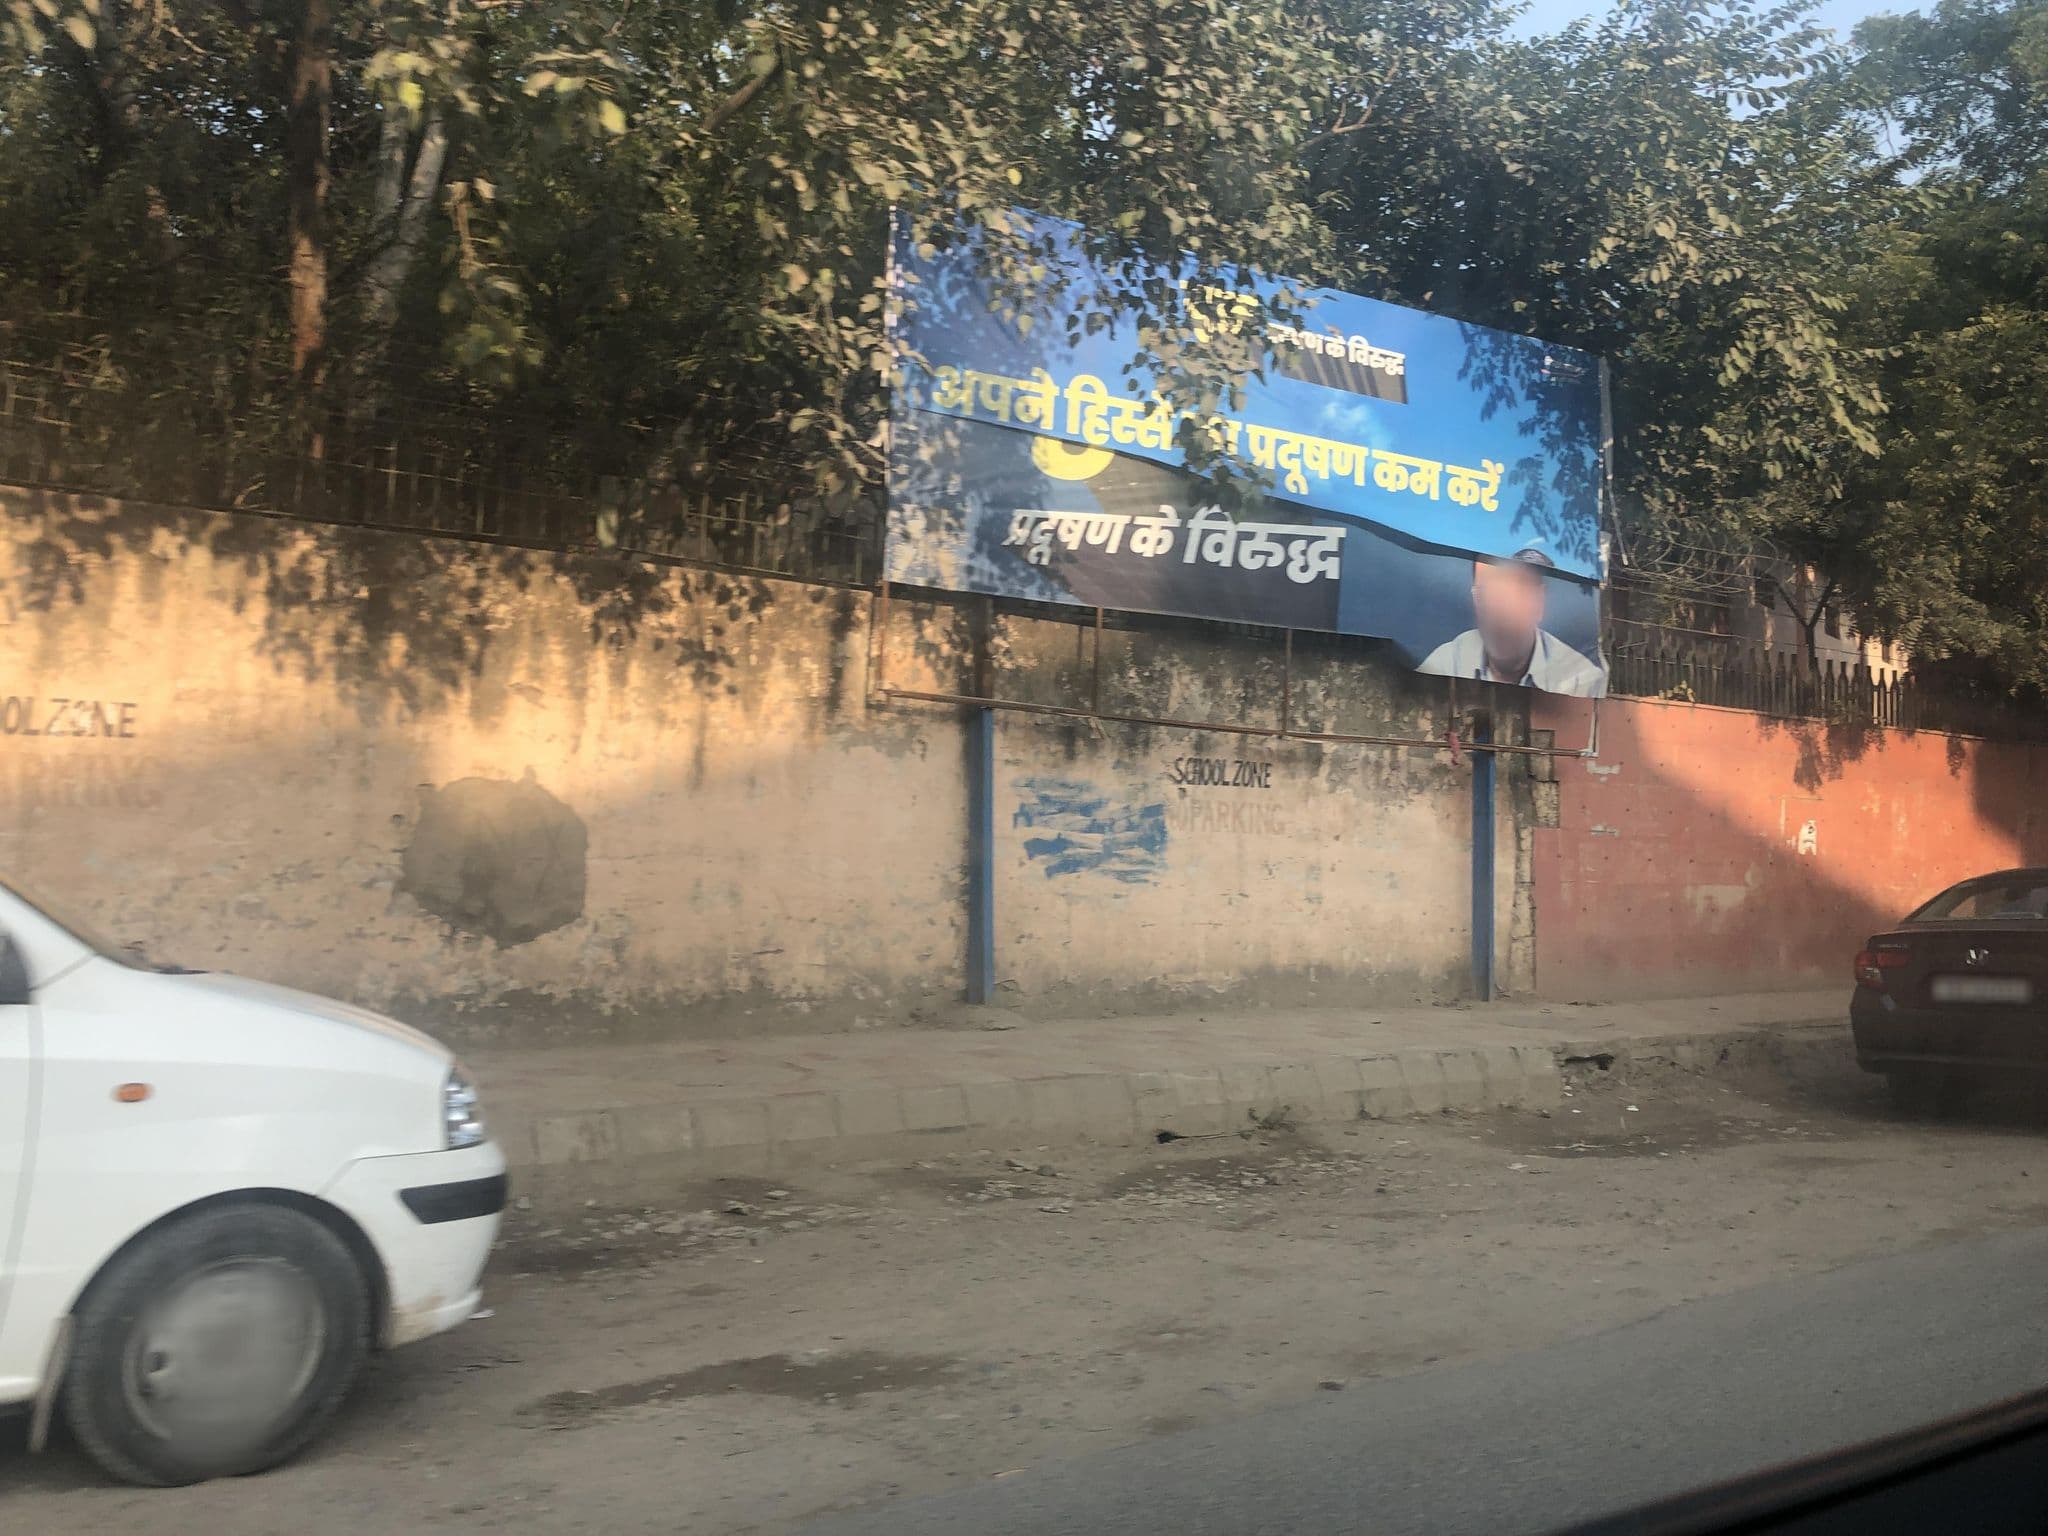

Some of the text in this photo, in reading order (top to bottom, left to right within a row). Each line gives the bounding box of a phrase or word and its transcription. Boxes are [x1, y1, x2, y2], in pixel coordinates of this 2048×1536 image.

[932, 366, 1060, 432] अपने
[1063, 374, 1174, 451] हिस्से
[1246, 423, 1369, 495] प्रदूषण
[1371, 449, 1443, 501] कम
[1446, 459, 1505, 512] करें
[1001, 503, 1348, 584] प्रदूषण के विरुद्ध
[1166, 756, 1273, 789] SCHOOL ZONE
